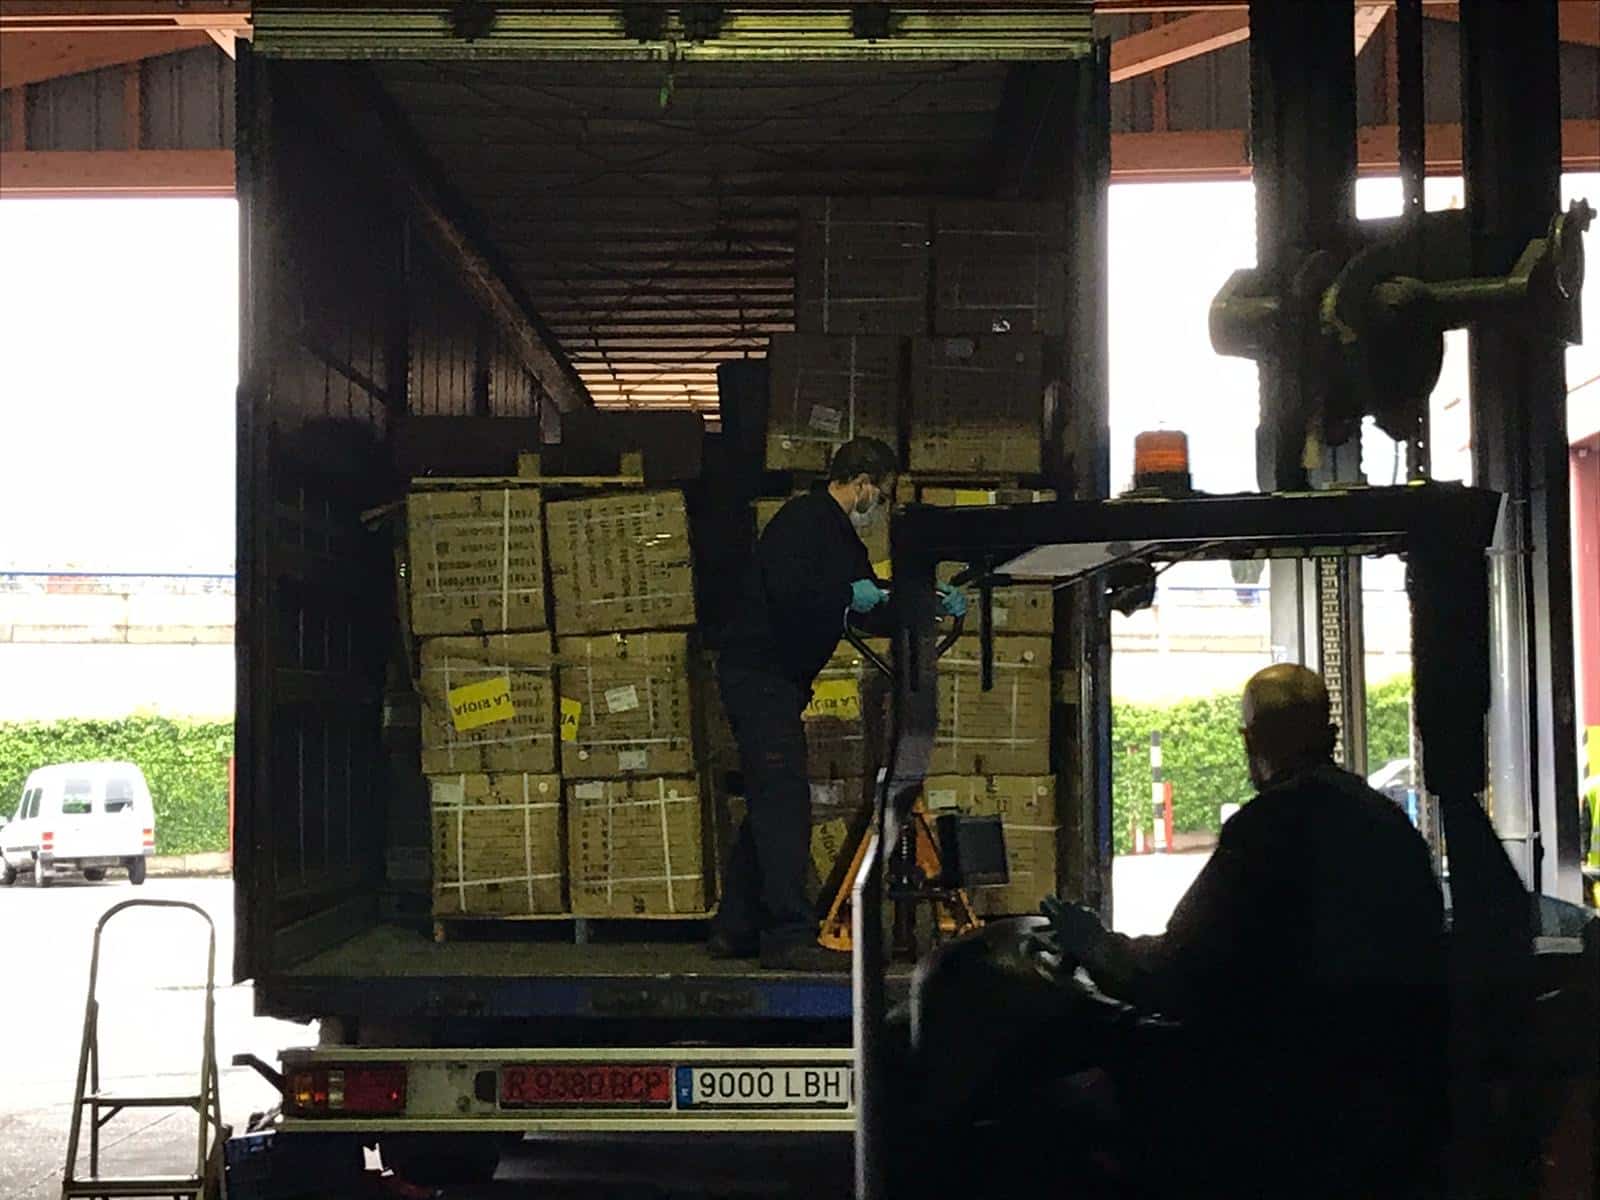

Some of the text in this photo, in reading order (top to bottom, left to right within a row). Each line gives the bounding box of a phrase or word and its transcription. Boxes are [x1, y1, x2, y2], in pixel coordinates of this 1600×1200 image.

[493, 693, 511, 706] LA
[840, 695, 858, 707] LA
[454, 699, 491, 716] RIOJA
[700, 1072, 840, 1098] 9000 LBH
